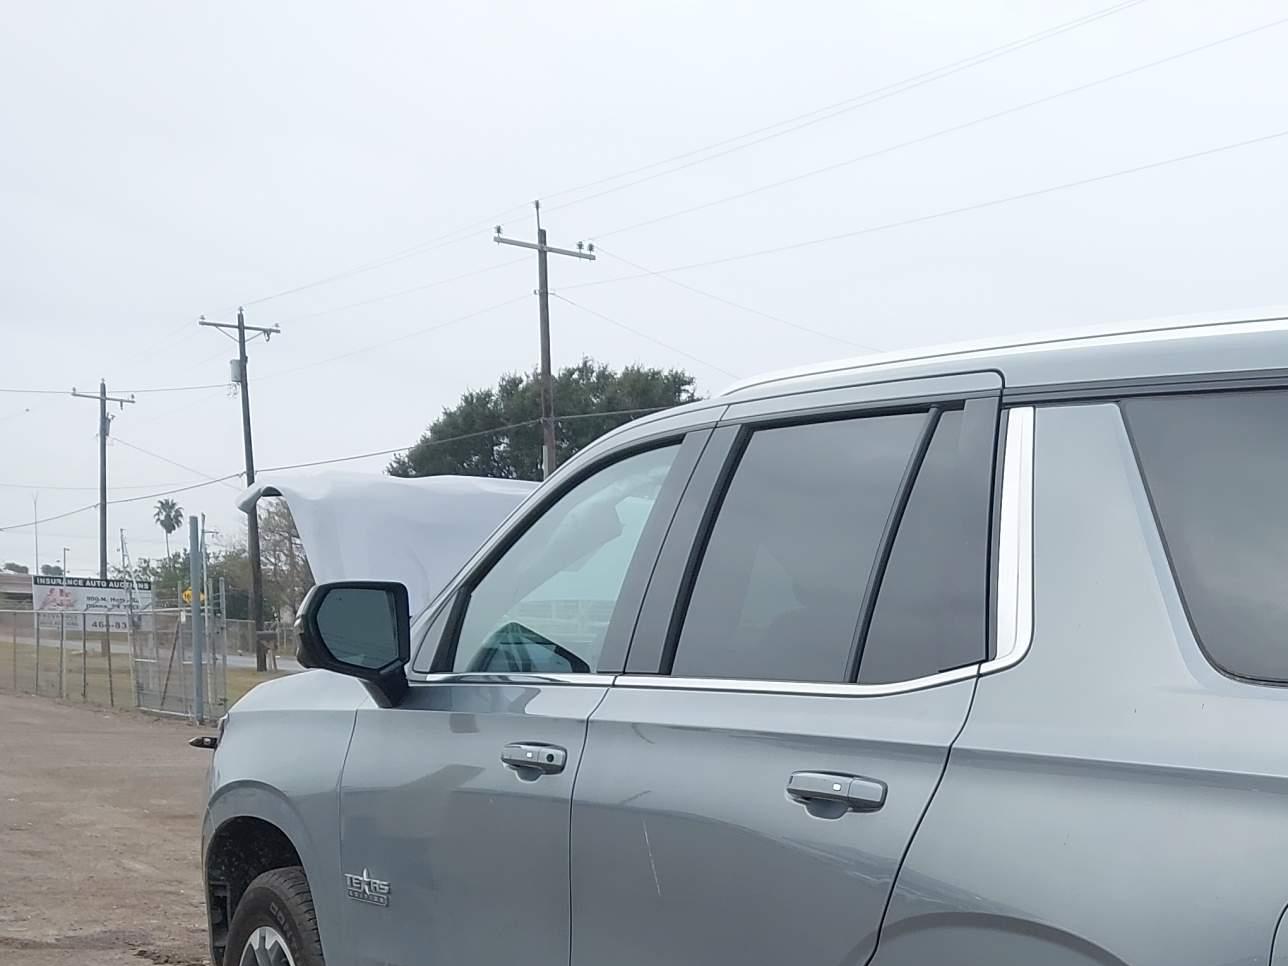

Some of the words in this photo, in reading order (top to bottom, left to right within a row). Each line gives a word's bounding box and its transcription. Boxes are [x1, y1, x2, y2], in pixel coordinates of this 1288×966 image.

[36, 577, 84, 586] INSURANCE
[86, 579, 107, 587] AUTO
[344, 867, 391, 895] TEXAS
